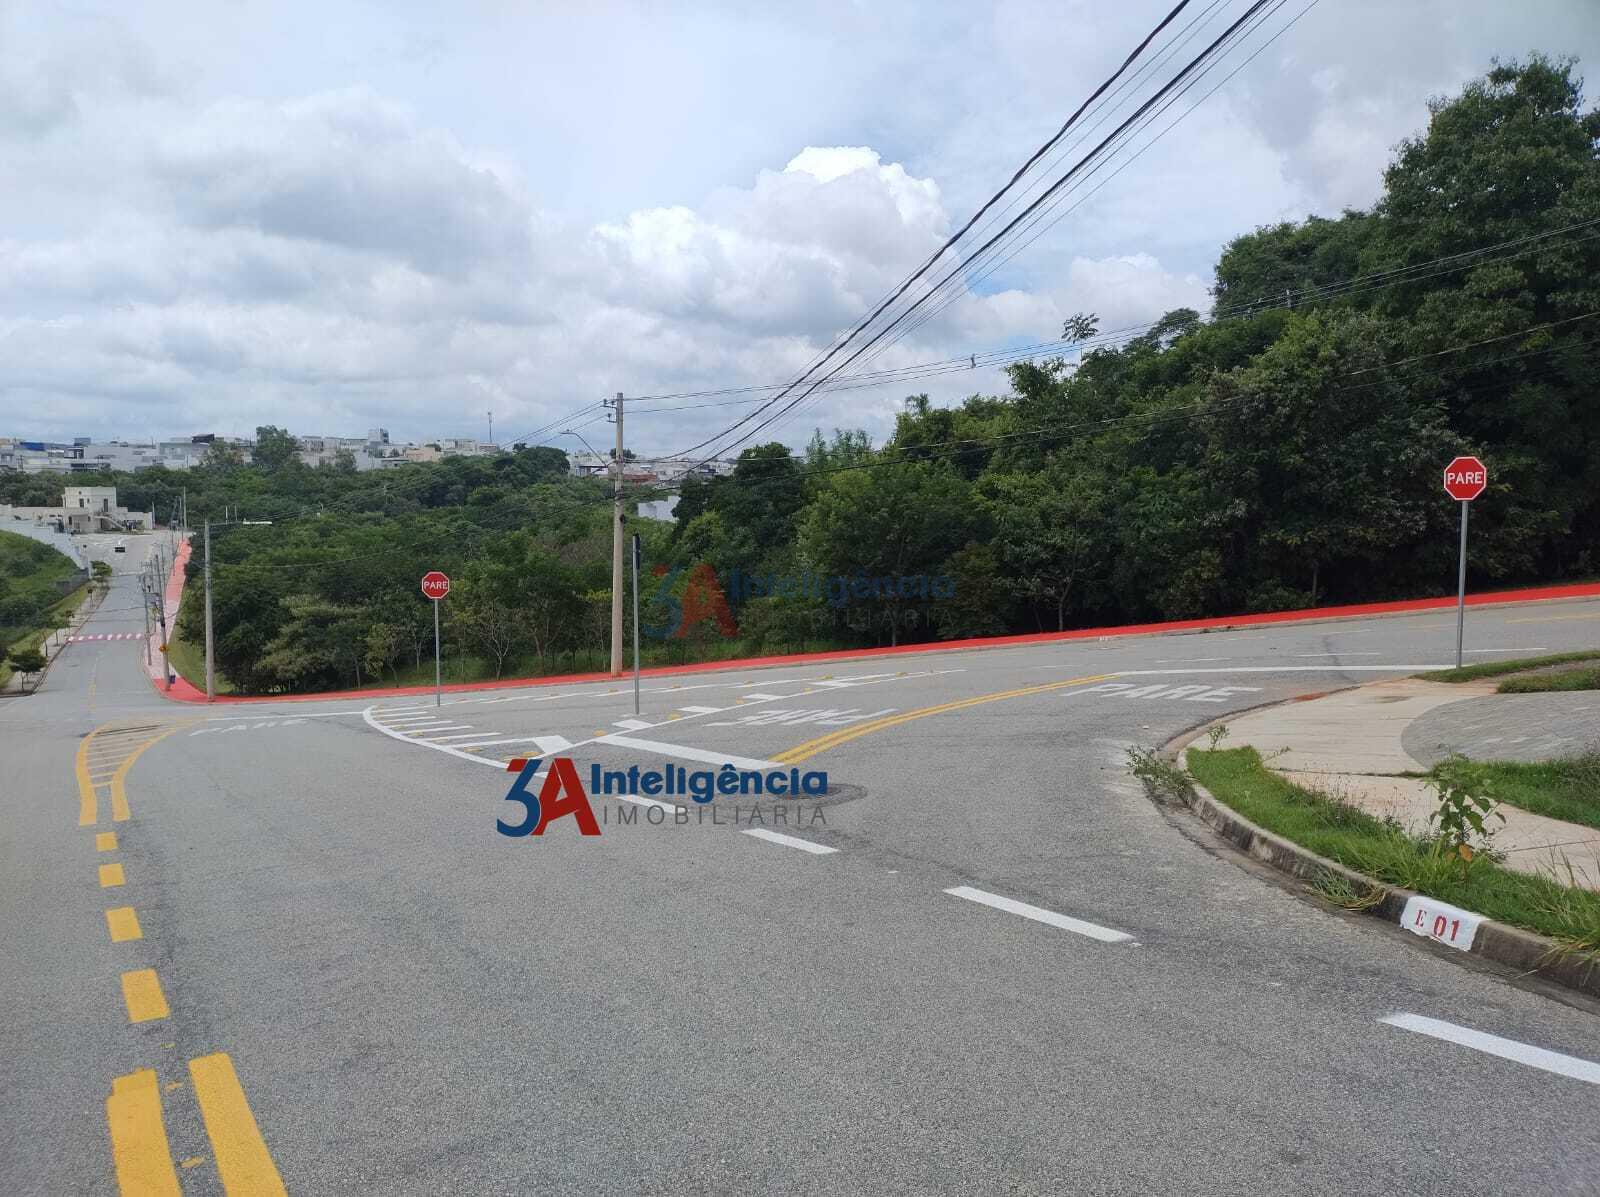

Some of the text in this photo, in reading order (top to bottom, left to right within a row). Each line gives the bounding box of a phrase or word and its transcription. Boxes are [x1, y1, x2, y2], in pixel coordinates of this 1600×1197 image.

[1447, 471, 1484, 485] PARE
[423, 581, 449, 590] PARE
[1059, 683, 1264, 703] PARE
[1433, 915, 1459, 941] 01
